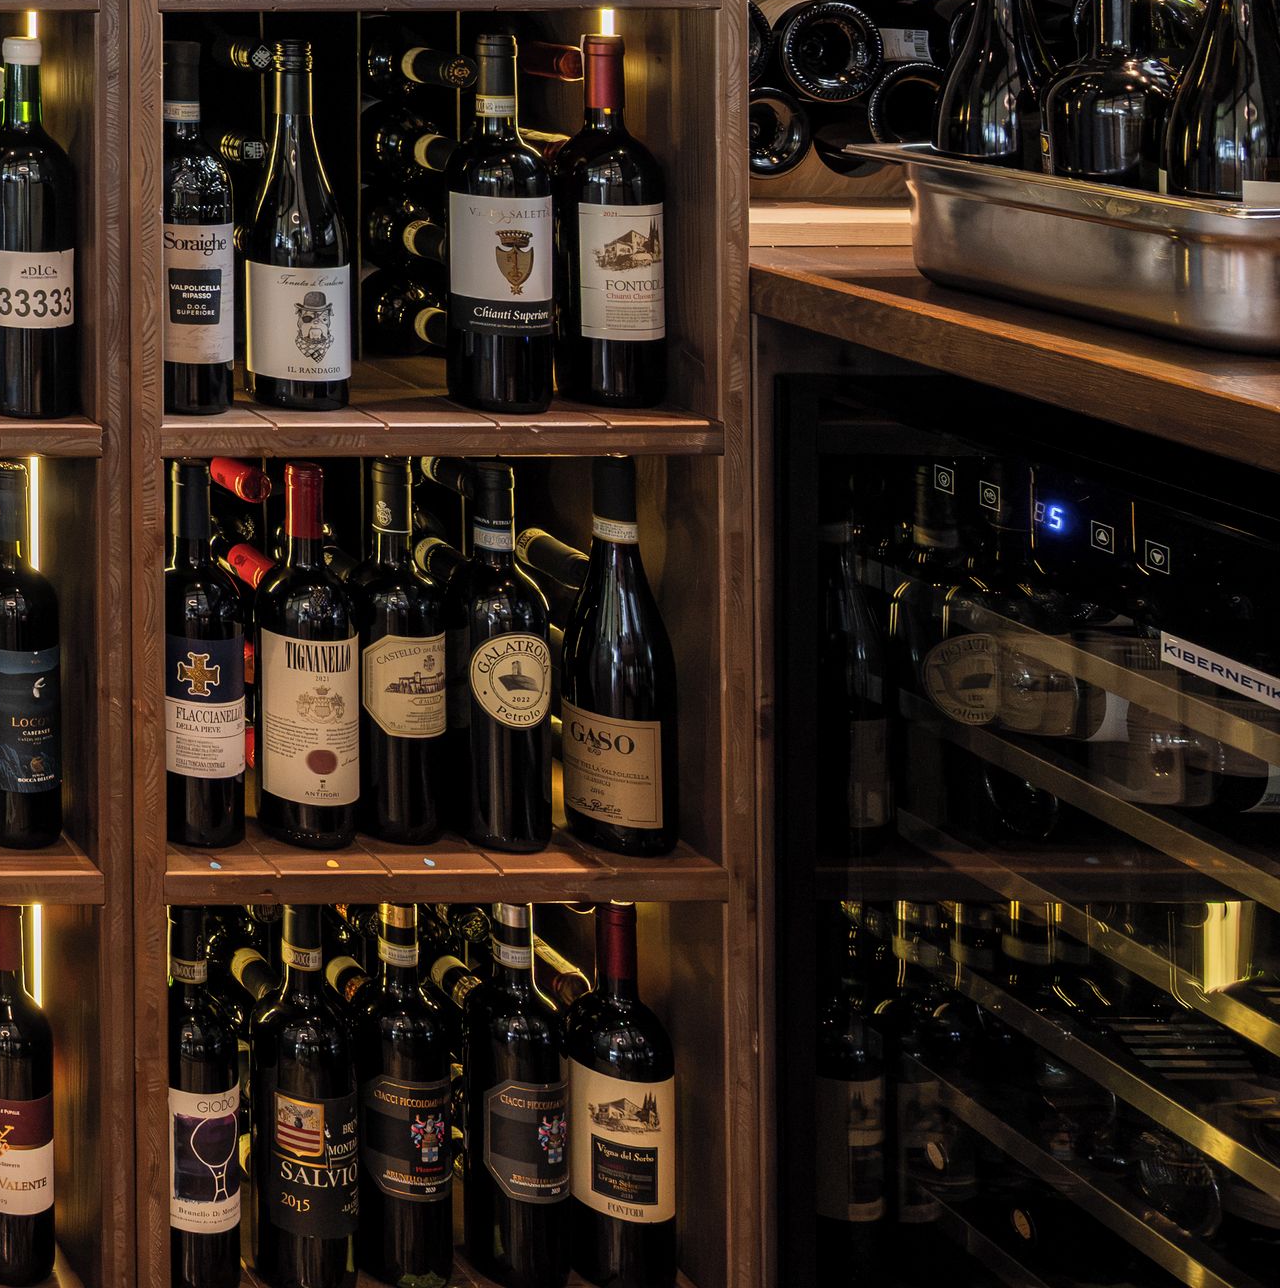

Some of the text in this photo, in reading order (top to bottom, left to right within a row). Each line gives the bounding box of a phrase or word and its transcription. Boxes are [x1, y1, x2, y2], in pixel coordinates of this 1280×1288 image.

[164, 231, 228, 256] Soraighe
[29, 264, 52, 276] DLC
[170, 284, 221, 292] VALPOLICELLA
[182, 292, 212, 300] RIPASSO
[474, 306, 512, 320] Chianti
[299, 366, 341, 374] RANDAGIO
[1048, 505, 1062, 530] 5
[285, 640, 352, 673] TIGNANELLO
[376, 646, 422, 664] CASTELLO
[478, 640, 550, 674] GALATRONA
[496, 704, 541, 724] Petrolo
[176, 722, 222, 734] DELLA PIEVE
[570, 721, 634, 755] GASO
[304, 790, 340, 798] ANTINORI
[196, 1095, 235, 1113] GIODO
[500, 1095, 526, 1108] CIACCI
[597, 1142, 654, 1162] Vigna del Sorbo
[281, 1192, 310, 1212] 2015
[608, 1202, 644, 1218] FONTODI
[178, 1206, 210, 1218] Brunello
